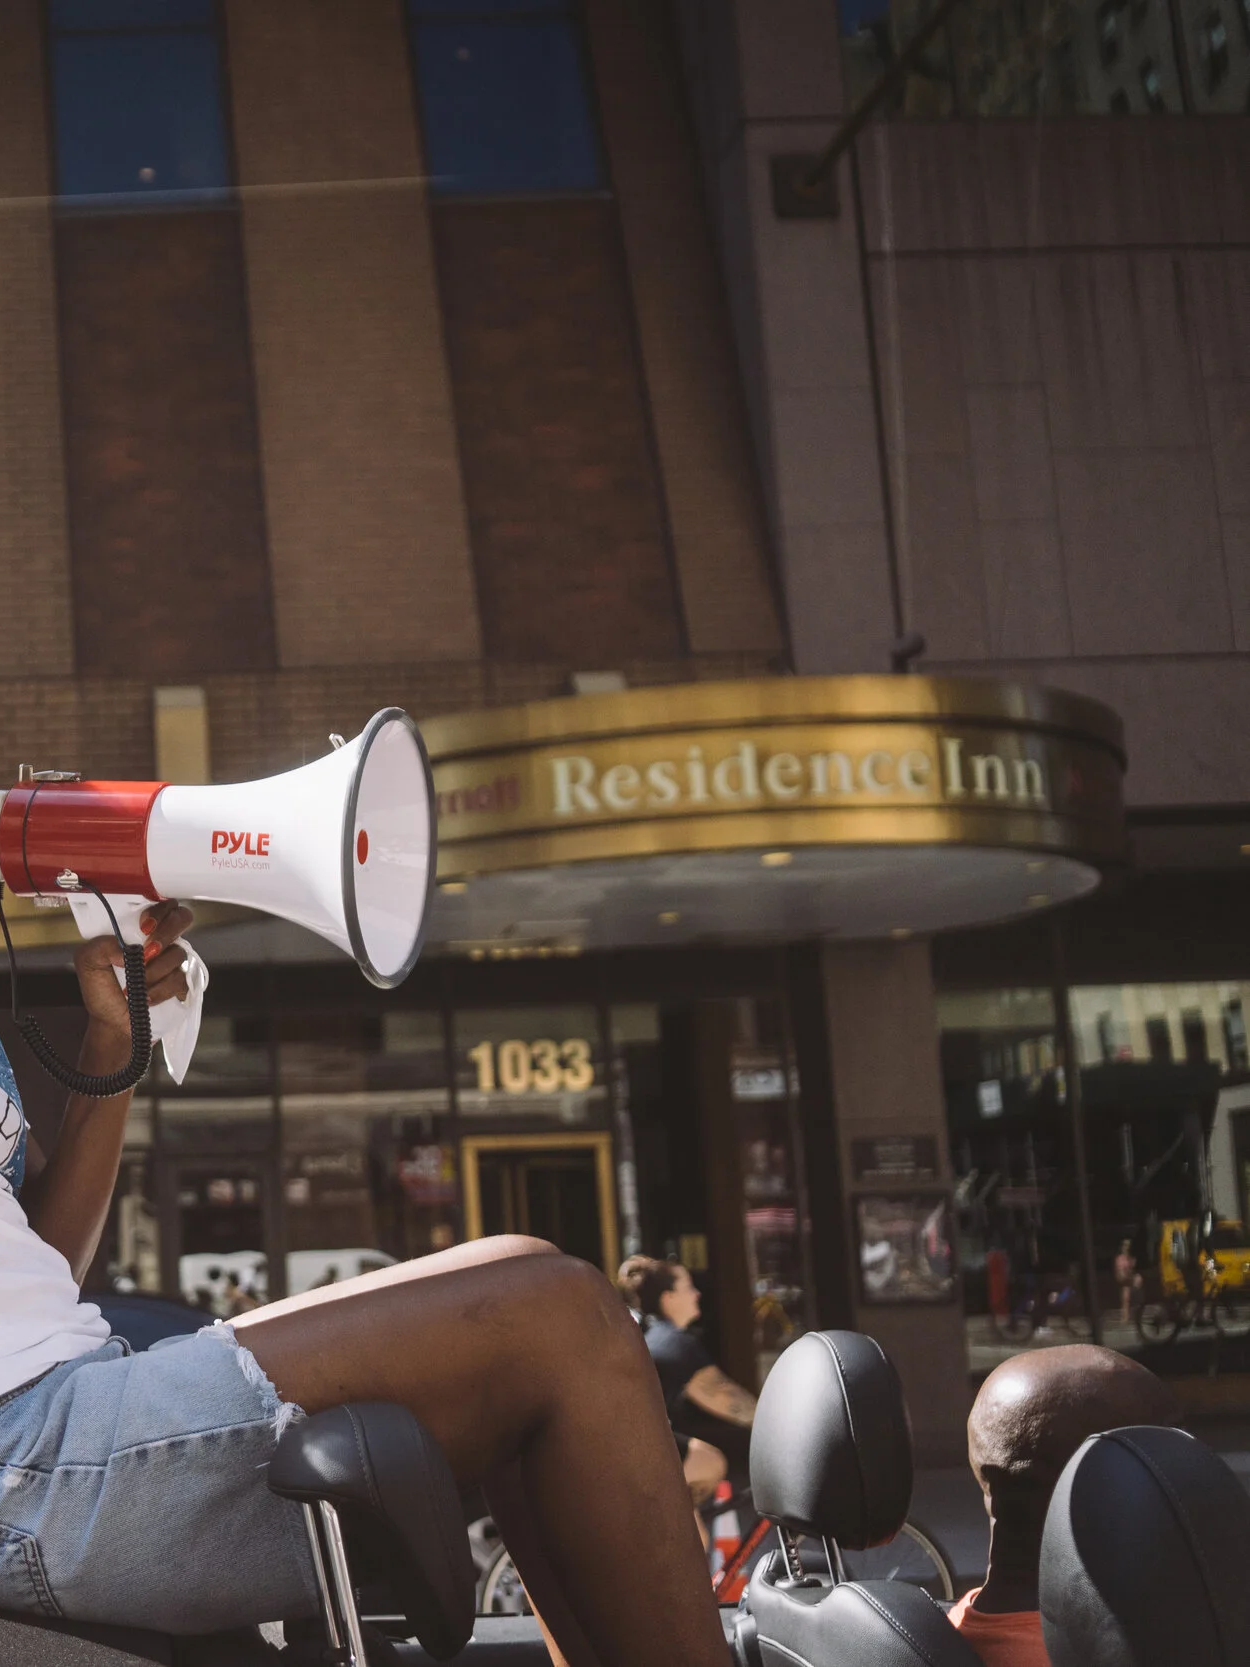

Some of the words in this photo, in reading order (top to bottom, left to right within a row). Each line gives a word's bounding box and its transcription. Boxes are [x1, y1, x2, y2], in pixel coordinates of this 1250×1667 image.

[552, 741, 932, 817] Residence
[943, 738, 1046, 800] Inn
[211, 830, 270, 856] PYLE
[211, 857, 270, 871] PyleUSA.com
[466, 1038, 594, 1094] 1033
